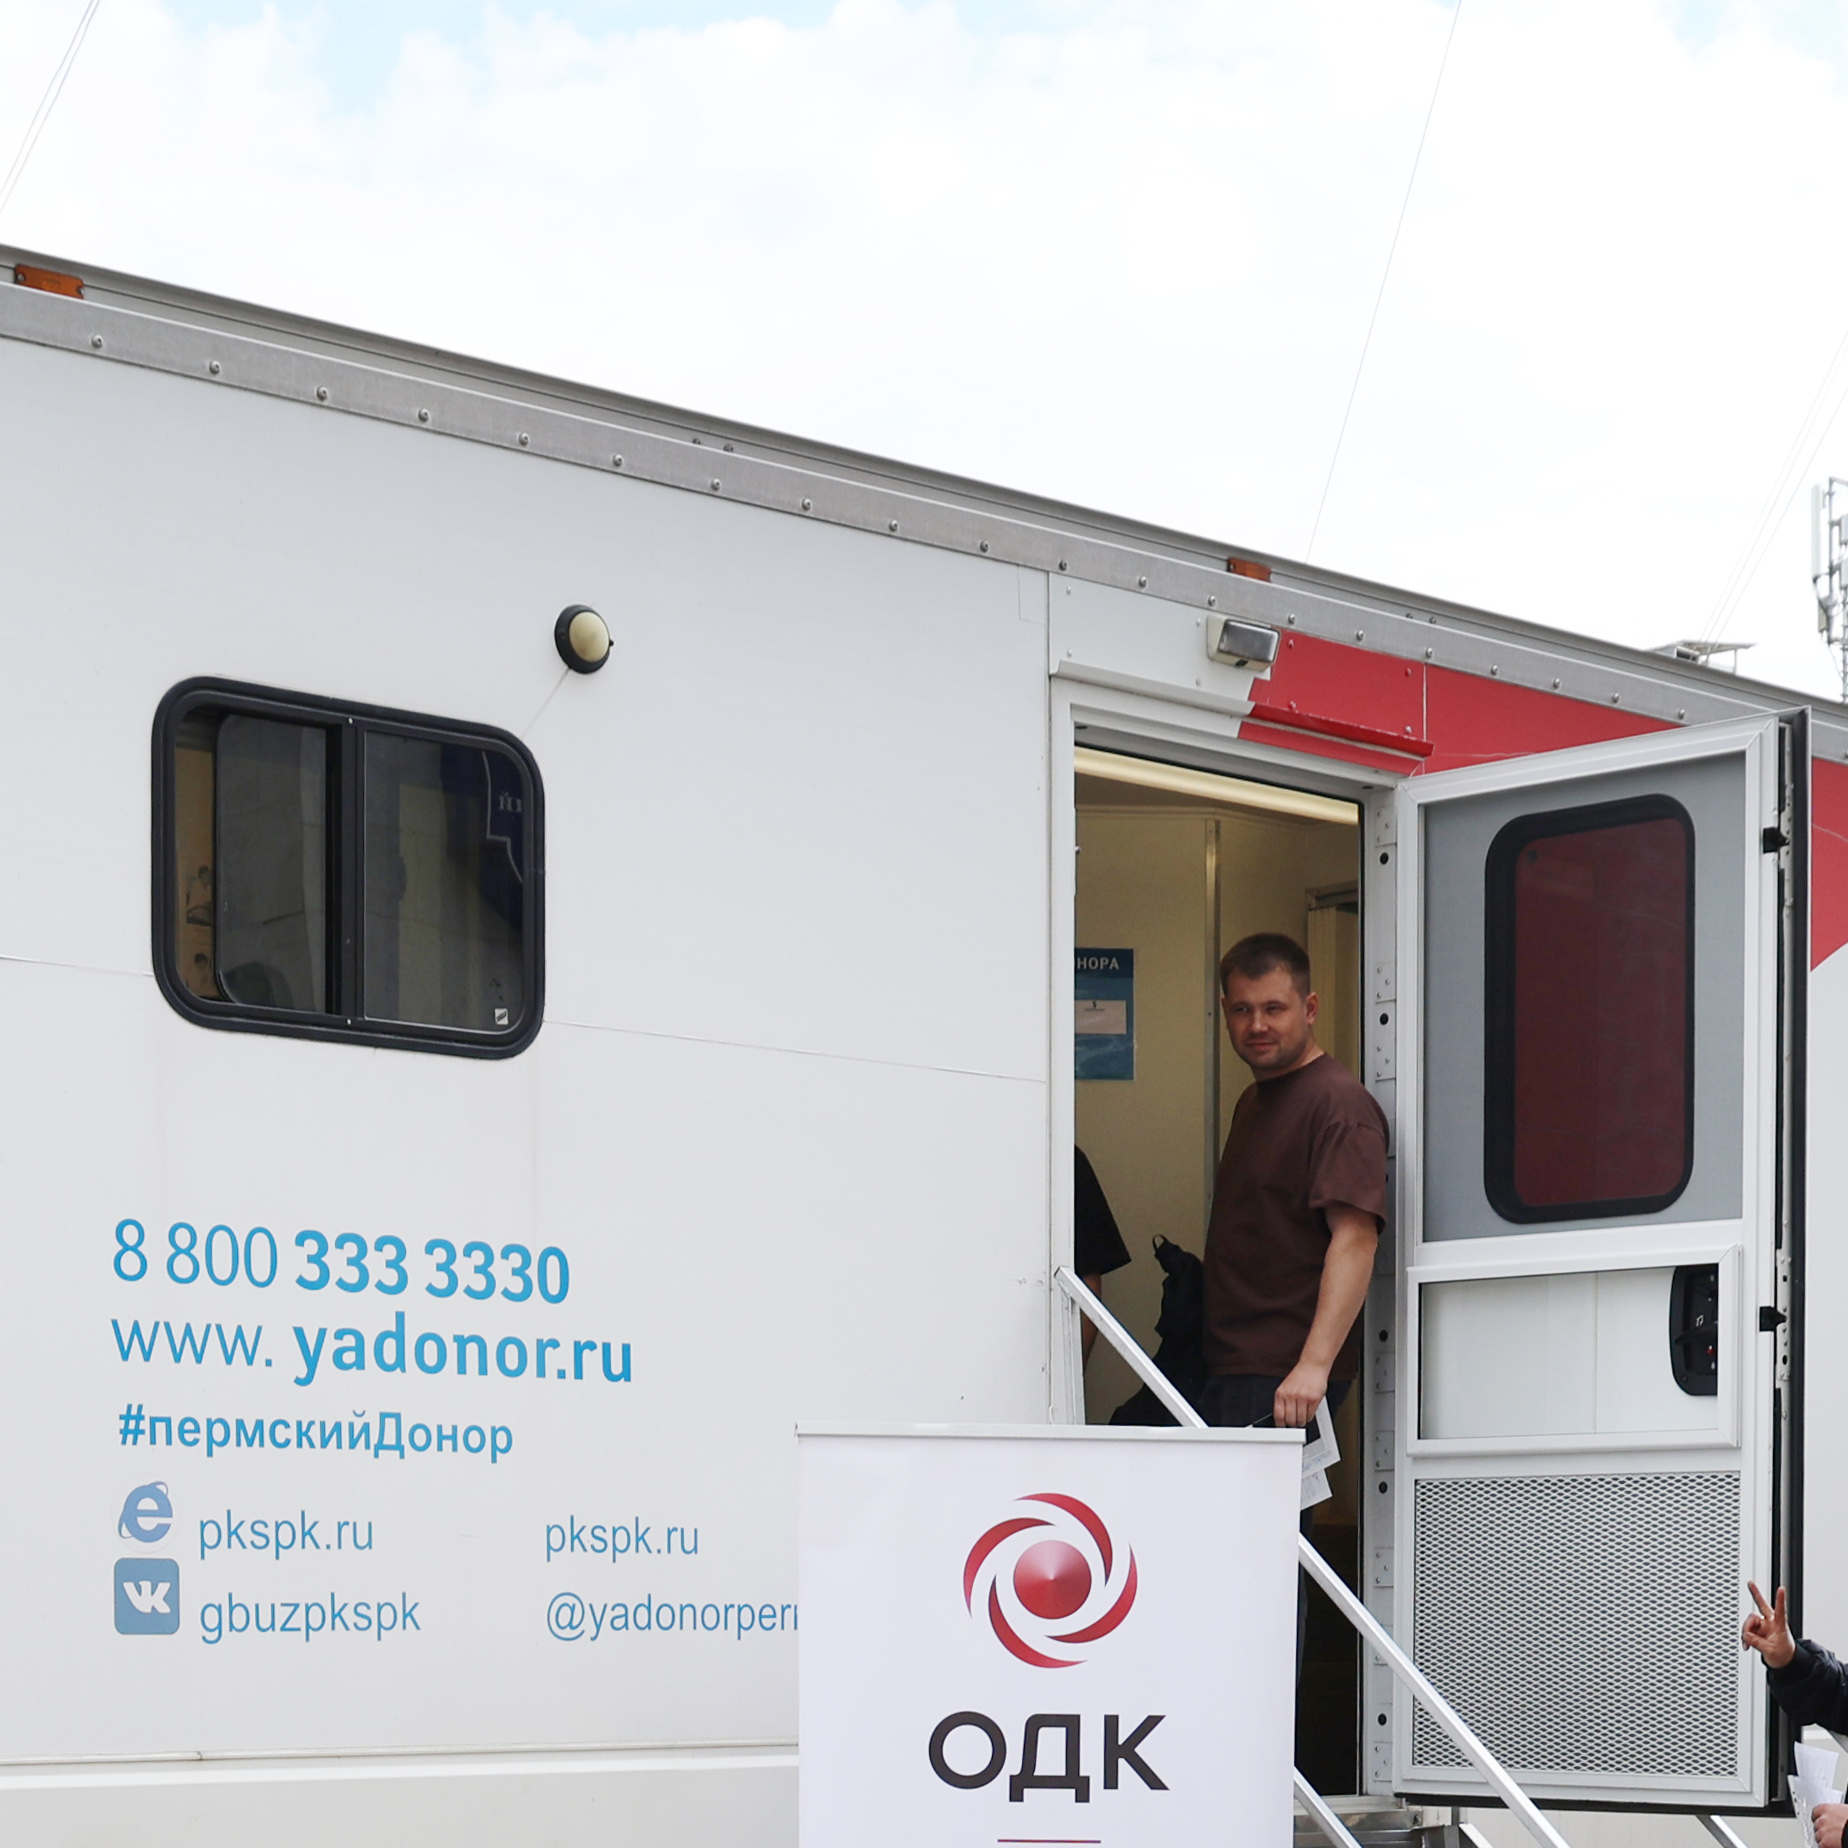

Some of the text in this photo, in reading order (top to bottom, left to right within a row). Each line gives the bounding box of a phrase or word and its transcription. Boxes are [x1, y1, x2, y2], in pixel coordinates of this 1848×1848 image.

[112, 1218, 571, 1305] 8 800 333 3330
[111, 1310, 632, 1388] www. yadonor.ru
[119, 1402, 513, 1465] #пермскийДонор
[199, 1509, 373, 1561] pkspk.ru
[546, 1515, 699, 1563] pkspk.ru
[199, 1591, 421, 1646] gbuzpkspk
[547, 1591, 799, 1642] @yadonorper
[928, 1711, 1169, 1804] ОДК
